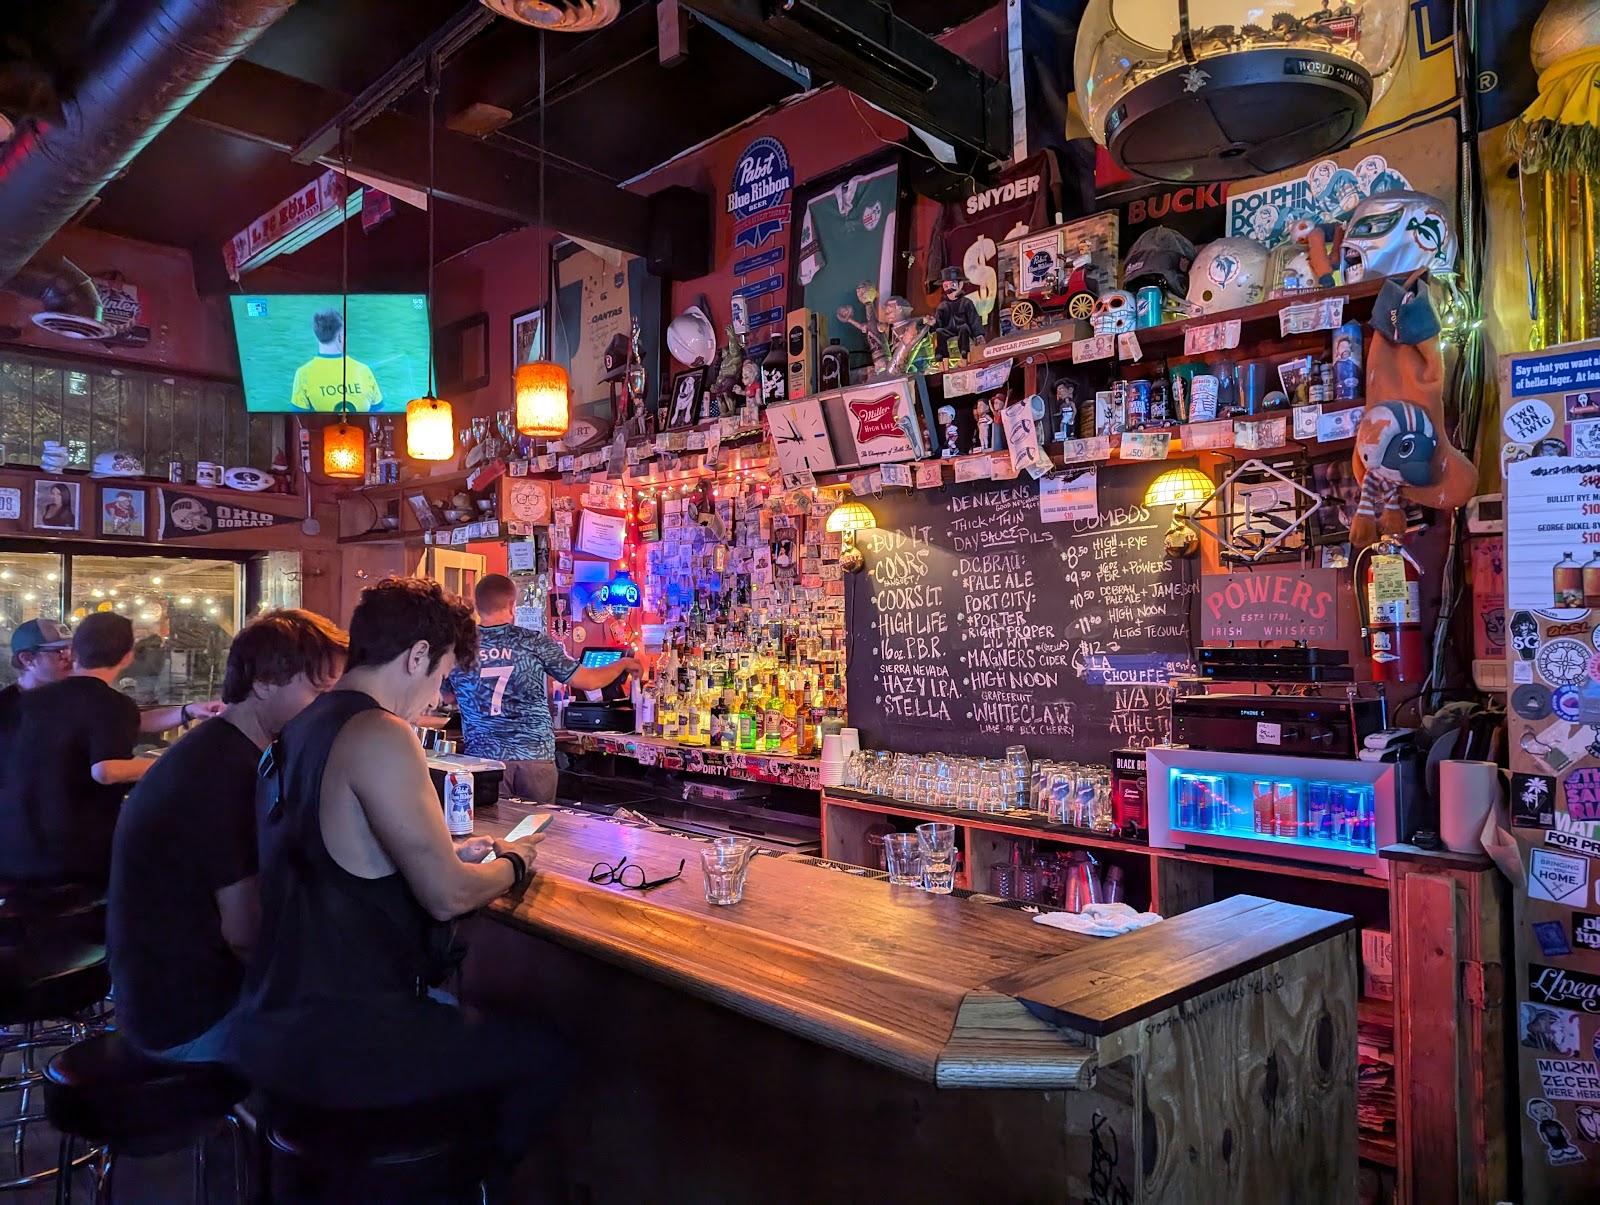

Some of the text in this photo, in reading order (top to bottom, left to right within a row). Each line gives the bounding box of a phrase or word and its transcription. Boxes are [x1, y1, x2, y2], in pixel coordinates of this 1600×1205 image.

[1329, 20, 1354, 29] dweiser
[1298, 61, 1335, 76] WORLD
[740, 152, 775, 187] Pabst
[727, 175, 790, 213] Blue Ribbon
[966, 175, 1040, 215] SNYDER
[748, 200, 768, 212] BEER
[592, 306, 623, 323] QANTAS
[992, 338, 1040, 355] POPULAR PRICES
[1515, 358, 1592, 377] Say what you want
[1516, 379, 1524, 389] of
[1525, 377, 1548, 388] helles
[1550, 375, 1573, 387] lager.
[1576, 372, 1586, 382] At
[319, 383, 362, 397] TOOLE
[859, 406, 890, 423] Miller
[1507, 404, 1535, 425] TWO
[1514, 411, 1540, 431] TON
[864, 422, 894, 433] HIGH LIFE
[1517, 415, 1551, 439] TWIG
[869, 449, 887, 457] Champagne
[952, 485, 1030, 513] DENIZENS
[996, 503, 1011, 512] GOOD
[1547, 494, 1591, 504] BULLEIT RYE
[217, 505, 274, 521] OHIO
[1064, 512, 1074, 520] $10
[1581, 503, 1600, 516] $10
[217, 519, 274, 528] BOBCATS
[951, 515, 988, 532] THICK
[996, 509, 1025, 527] THIN
[1073, 504, 1151, 533] COMBOS
[1538, 523, 1564, 532] GEORGE
[1566, 522, 1590, 531] DICKEL
[872, 529, 907, 554] BUD
[954, 525, 1054, 552] DAY SAUCE PILS
[1093, 533, 1118, 551] HIGH
[1127, 536, 1148, 551] RYE
[1582, 532, 1600, 544] $10
[1095, 548, 1119, 561] LIFE
[876, 549, 930, 584] COORS
[1129, 560, 1173, 576] POWERS
[969, 571, 1035, 593] PALE ALE
[878, 585, 943, 612] COORS LT.
[965, 593, 999, 614] PORT
[1104, 594, 1142, 606] PALE ALE
[1206, 575, 1333, 620] POWERS
[974, 611, 1027, 628] PORTER
[1108, 607, 1134, 624] HIGH
[1137, 603, 1167, 618] NOON
[878, 611, 949, 638] HIGH LIFE
[968, 625, 1055, 640] RIGHT PROPER
[1112, 623, 1190, 640] ALTOS TEQUILA
[1211, 626, 1326, 636] IRISH WHISKEY
[983, 636, 1029, 649] LIL WIT
[1079, 640, 1107, 657] $12
[1513, 634, 1541, 651] SG
[479, 648, 513, 661] SON
[967, 648, 1068, 669] MAGNERS CIDER
[1091, 656, 1111, 669] LA
[880, 664, 950, 678] SIERRA NEVADA
[1103, 668, 1166, 683] CHOUFFE
[882, 675, 926, 697] HAZY
[971, 671, 1058, 690] HIGH NOON
[480, 665, 515, 717] 7
[981, 691, 1033, 703] GRAPEFRUIT
[1115, 687, 1150, 711] N/A
[884, 695, 952, 720] STELLA
[980, 724, 1000, 734] LIME
[1040, 725, 1075, 737] CHERRY
[1109, 712, 1172, 735] ATHLETI
[702, 764, 729, 777] DIRTY
[1116, 758, 1135, 769] BLACK
[1548, 831, 1577, 848] FOR
[1540, 858, 1580, 871] BRINGING
[1539, 871, 1579, 886] HOME.
[1544, 1087, 1600, 1099] WERE HERE
